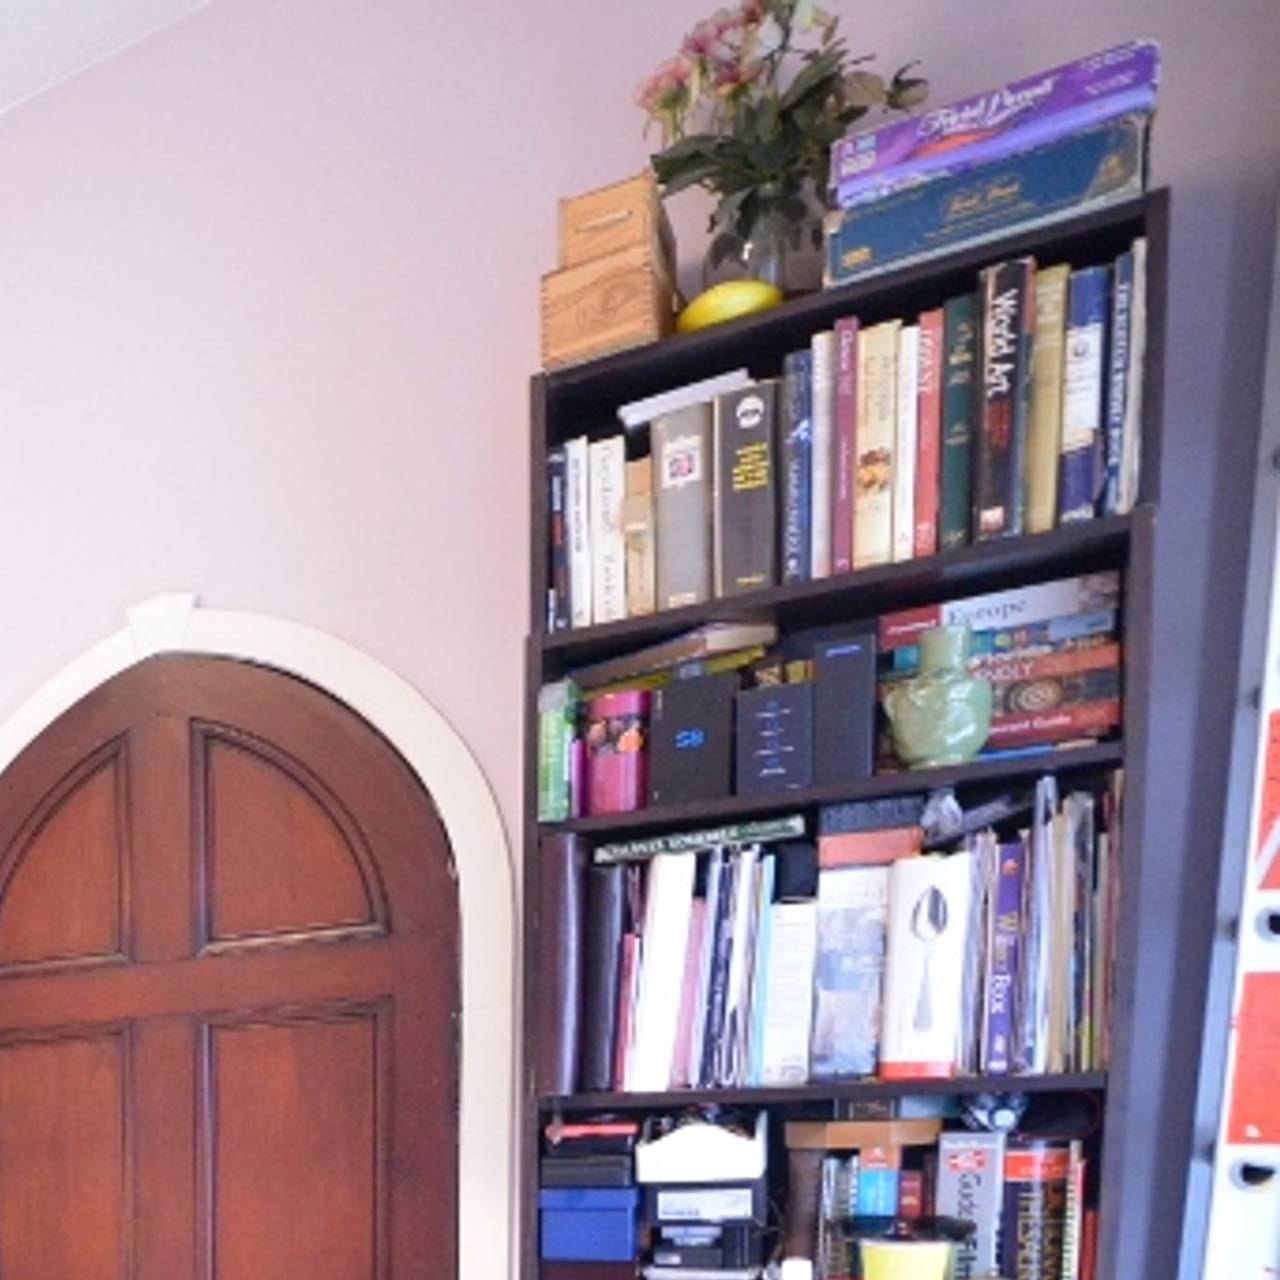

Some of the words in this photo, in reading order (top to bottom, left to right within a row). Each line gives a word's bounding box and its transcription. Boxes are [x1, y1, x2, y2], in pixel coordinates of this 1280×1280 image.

[987, 288, 1019, 362] World
[986, 362, 1015, 399] Art
[948, 598, 1026, 626] Europe
